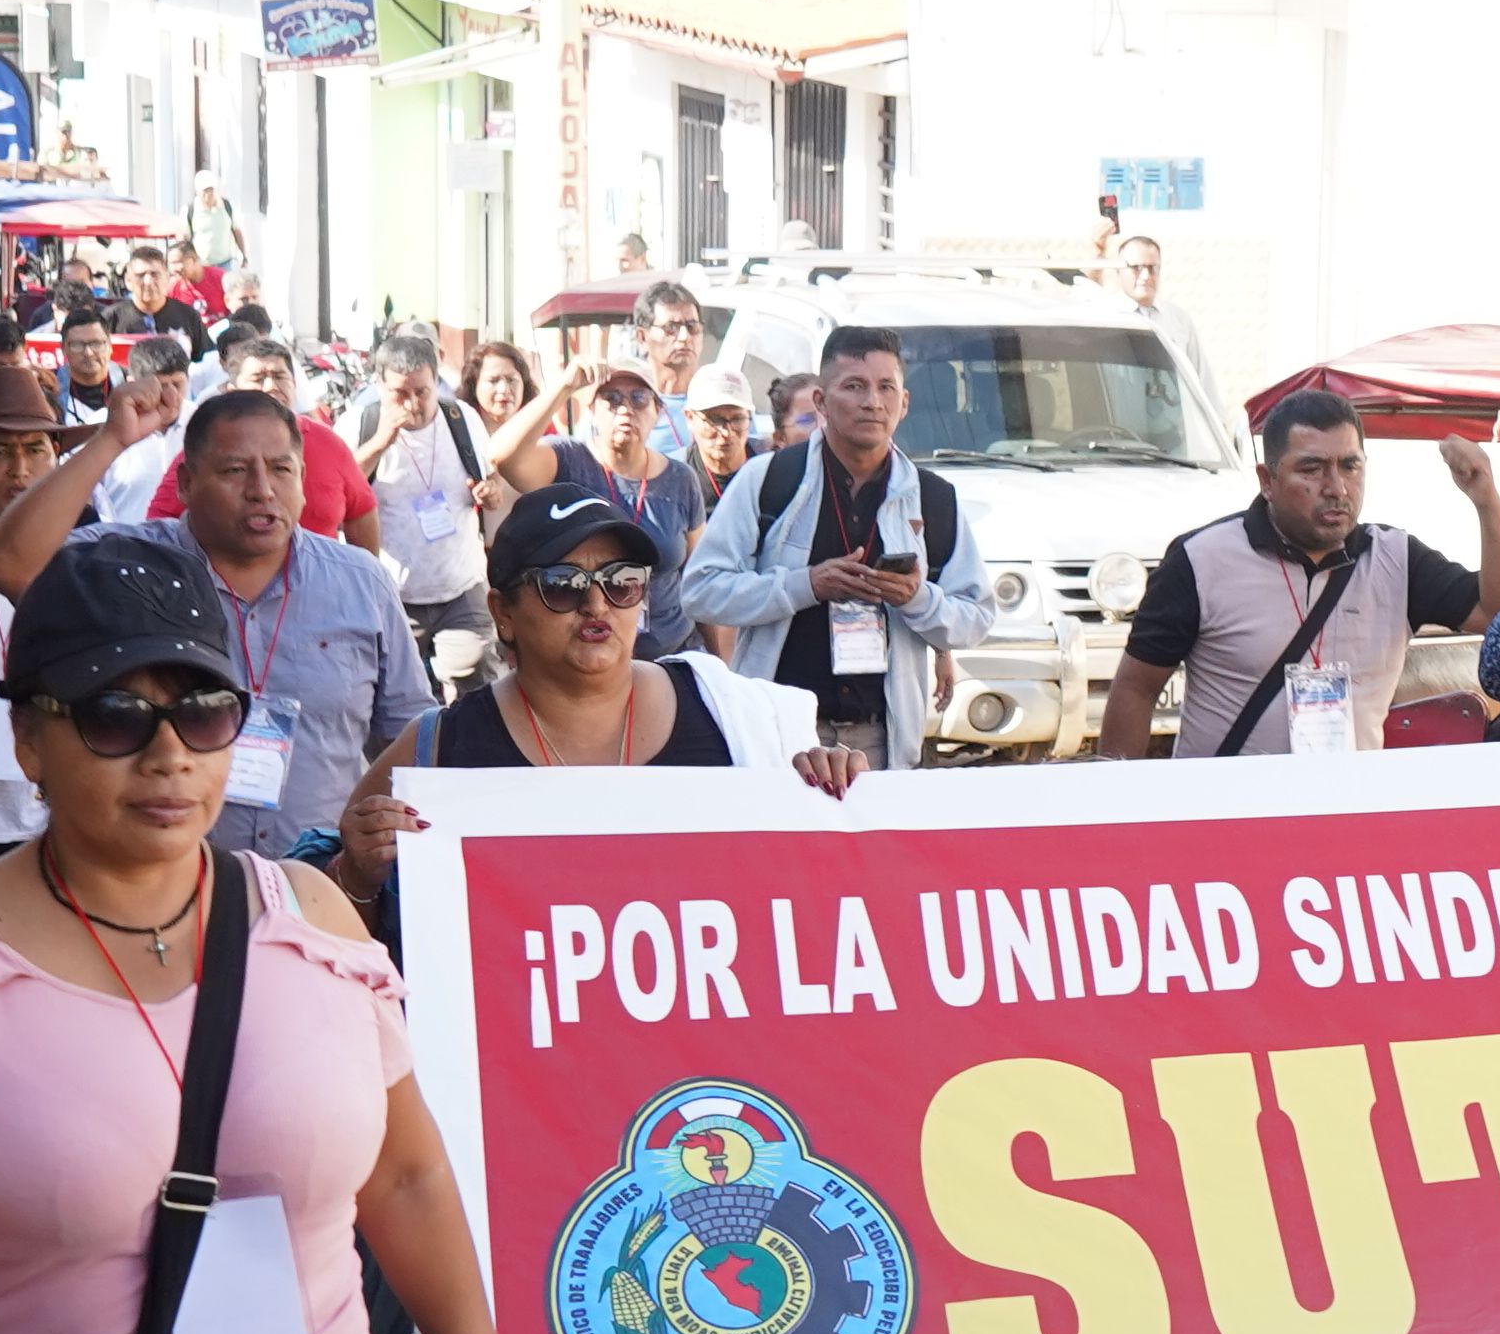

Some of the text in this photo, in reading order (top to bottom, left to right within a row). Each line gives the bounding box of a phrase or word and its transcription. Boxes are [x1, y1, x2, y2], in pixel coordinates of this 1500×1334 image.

[523, 897, 749, 1050] ¡POR
[771, 895, 897, 1015] LA
[921, 881, 1259, 1008] UNIDAD
[821, 1178, 847, 1200] EN
[844, 1197, 868, 1220] LA
[568, 1284, 586, 1304] DE
